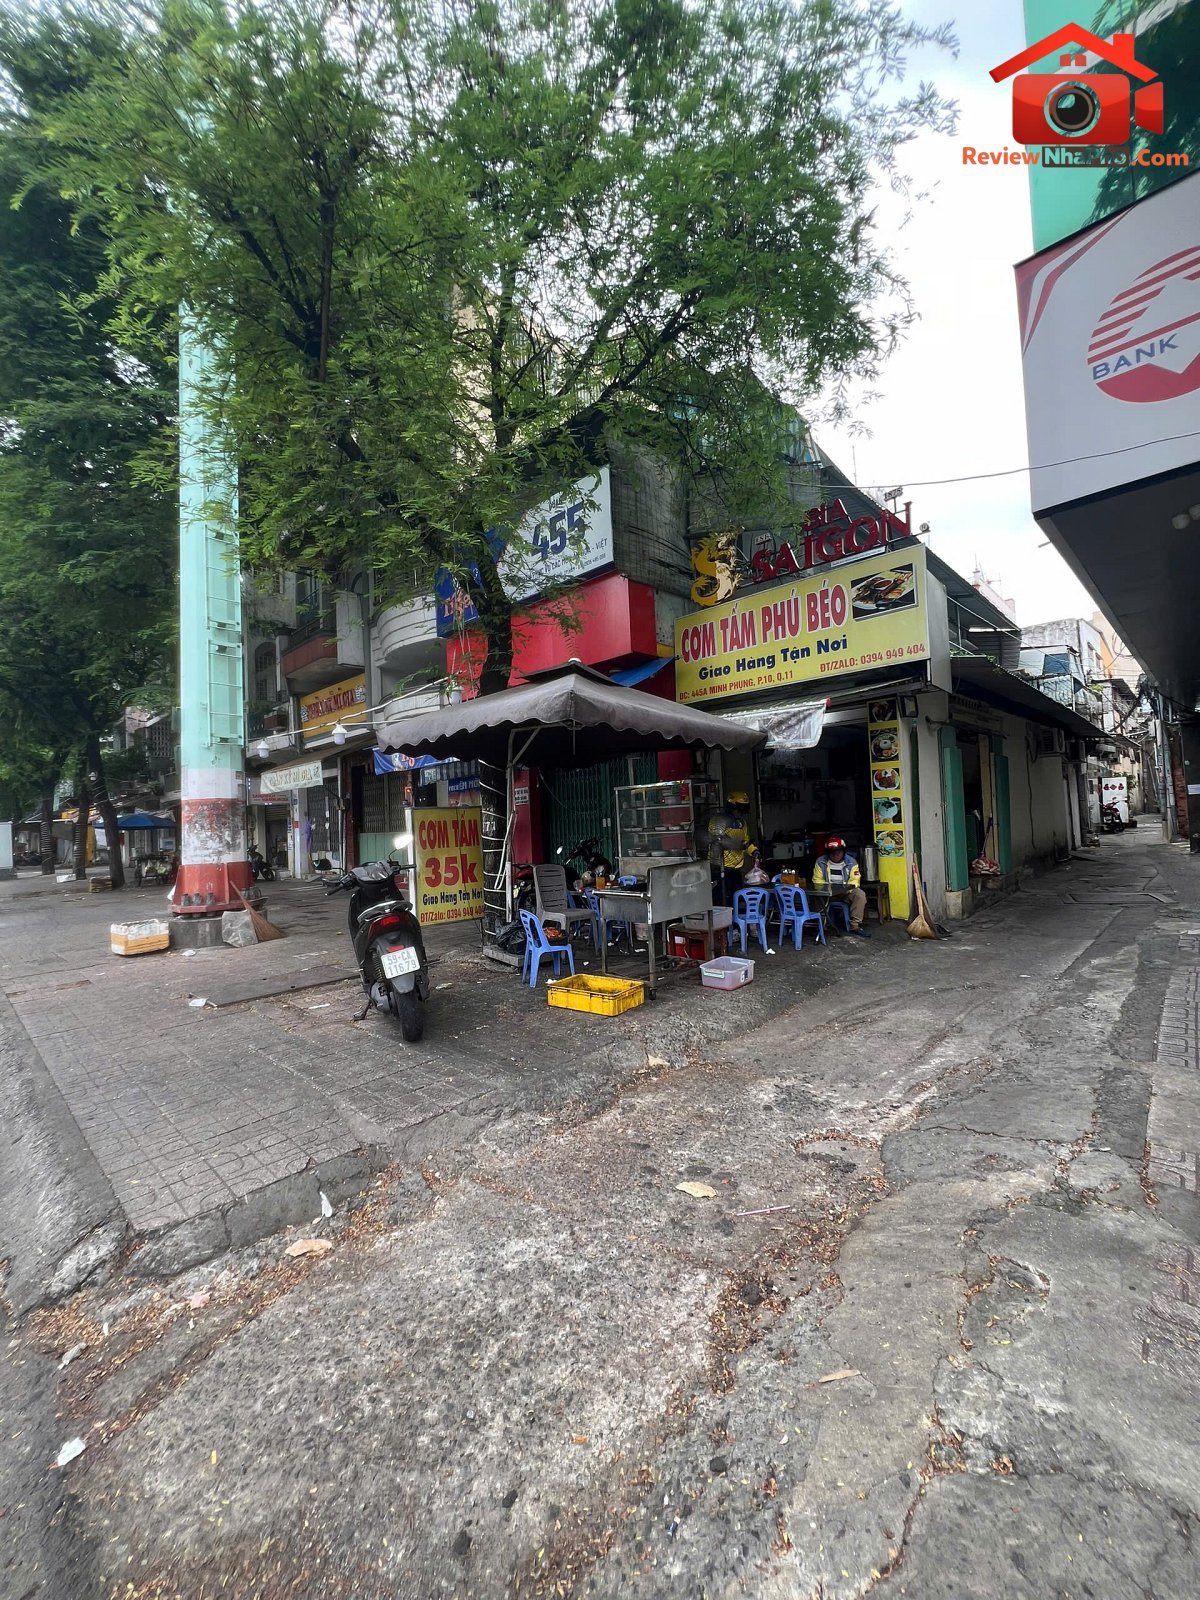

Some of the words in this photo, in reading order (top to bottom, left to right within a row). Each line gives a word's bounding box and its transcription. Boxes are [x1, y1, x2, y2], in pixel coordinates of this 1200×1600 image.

[1092, 333, 1179, 381] BANK
[531, 499, 586, 560] 455
[752, 501, 912, 585] SAIGON
[720, 603, 757, 653] TẤM
[762, 589, 800, 643] PHÚ
[807, 579, 846, 632] BÉO
[699, 663, 731, 680] Giao
[736, 654, 776, 672] Hàng
[781, 646, 810, 665] Tận
[816, 634, 848, 654] Nơi
[820, 657, 858, 672] ĐT/ZALO:
[861, 652, 883, 665] 0394
[886, 647, 904, 660] 949
[907, 643, 926, 656] 404
[709, 684, 727, 694] MINH
[729, 679, 756, 692] PHỤNG,
[757, 674, 775, 685] P.10,
[777, 670, 793, 682] Q.11
[419, 820, 449, 850] CƠM
[452, 810, 480, 848] TẤM
[425, 854, 478, 888] 35k
[420, 911, 446, 923] ĐT/Zalo:
[446, 908, 461, 920] 0394
[463, 906, 473, 917] 949
[423, 893, 438, 905] Giao
[388, 959, 417, 976] 116.79
